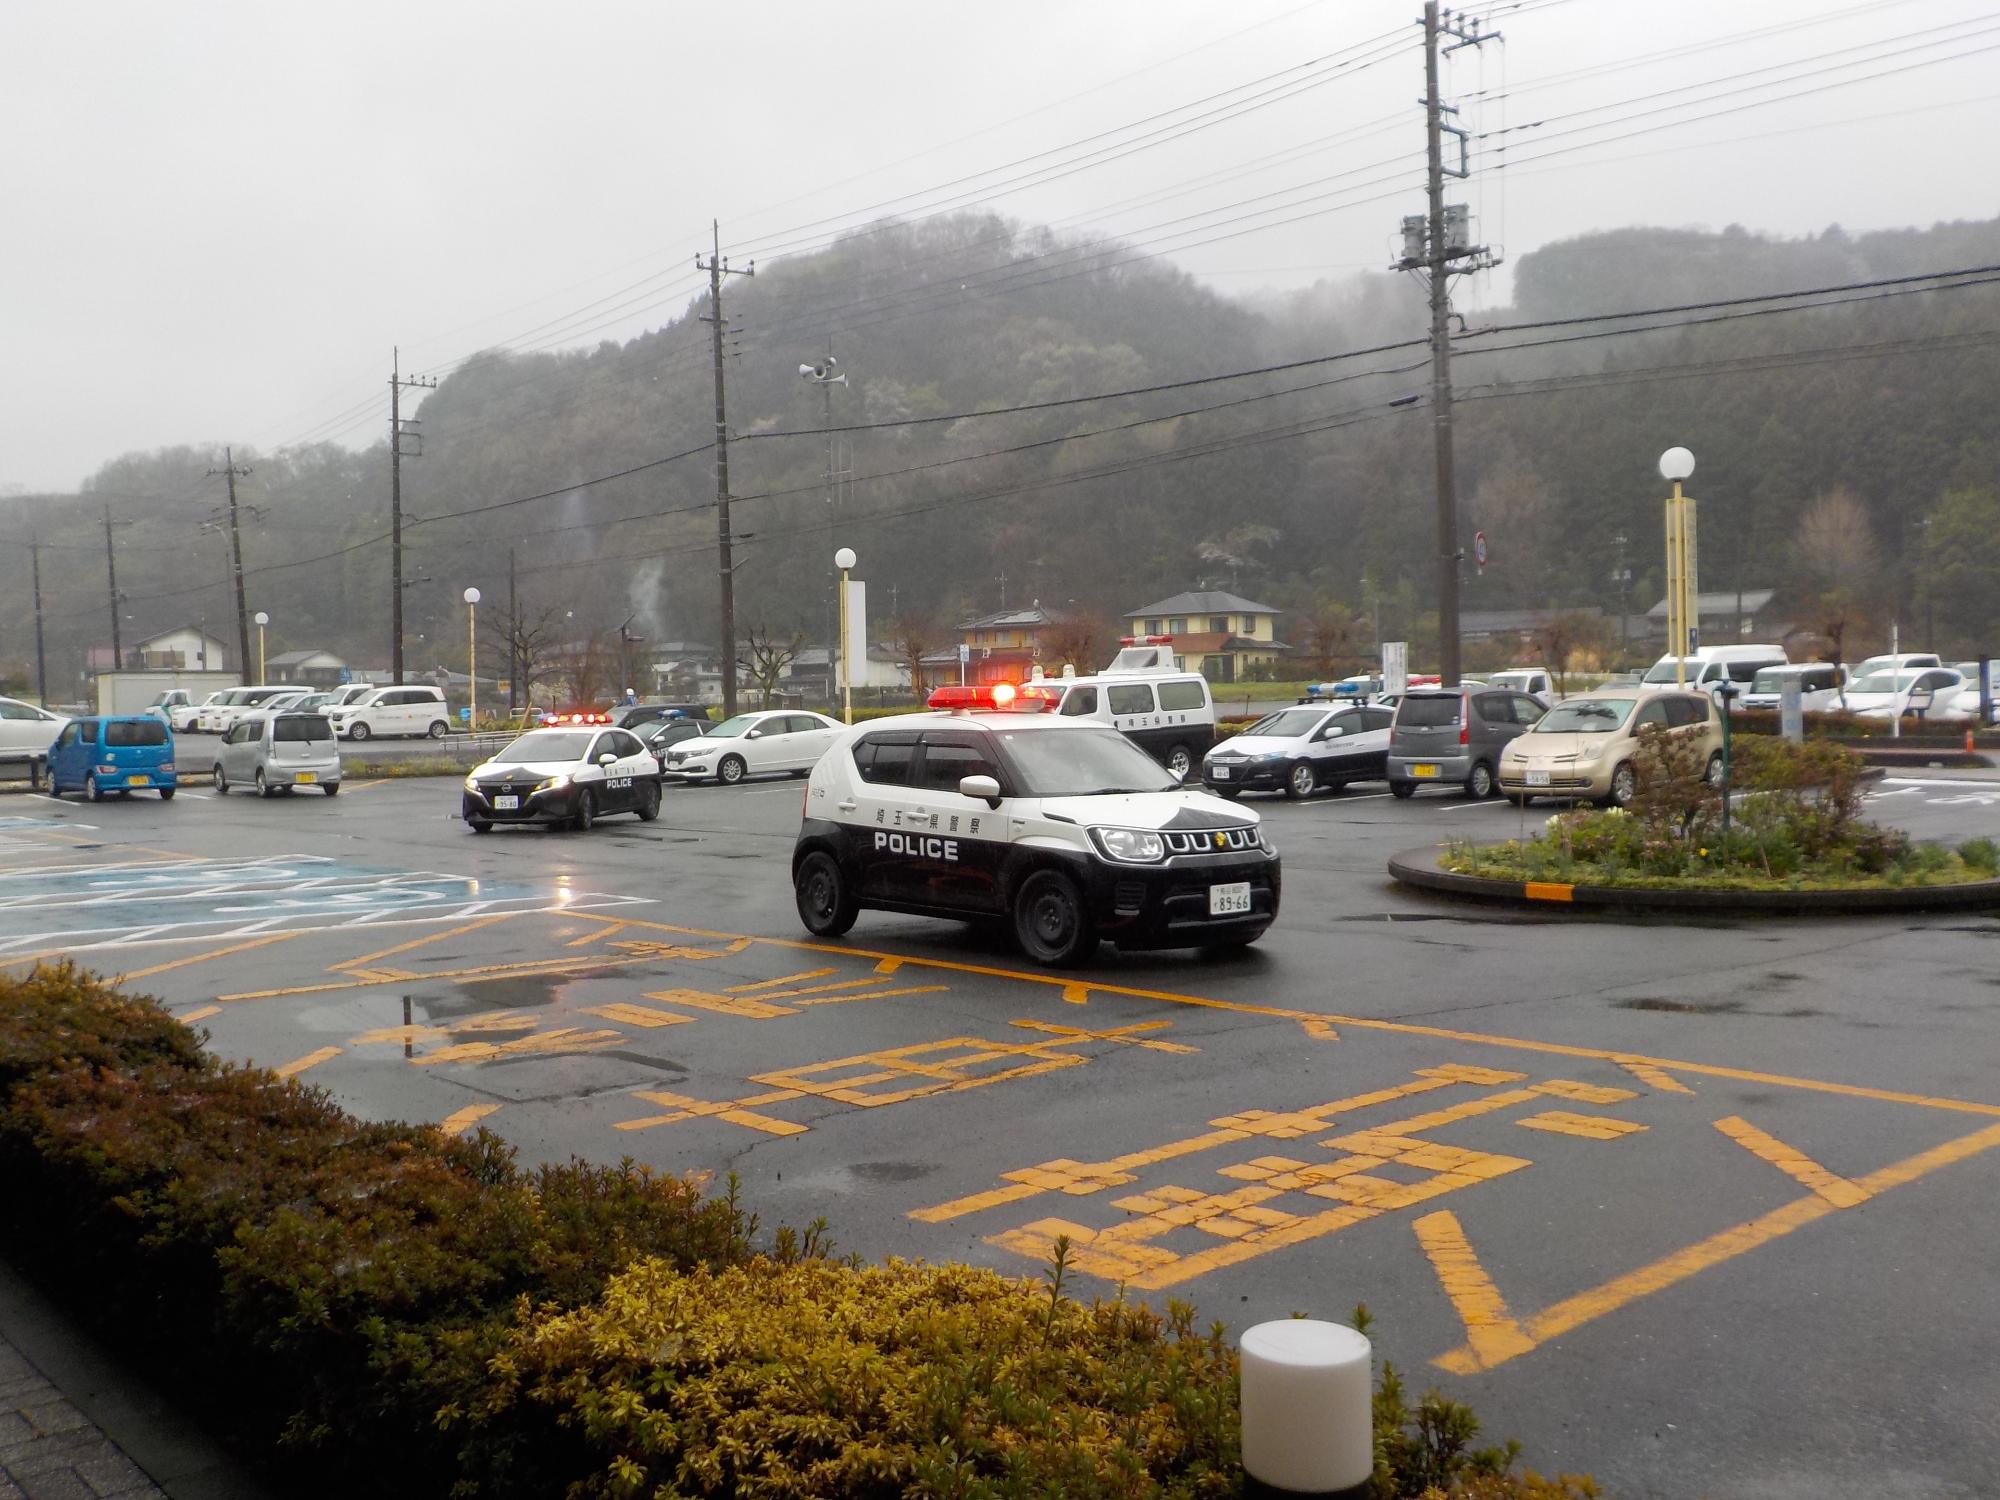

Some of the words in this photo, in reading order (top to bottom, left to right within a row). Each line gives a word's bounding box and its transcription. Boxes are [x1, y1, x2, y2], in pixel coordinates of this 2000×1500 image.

[606, 777, 632, 789] POLICE
[876, 807, 981, 835] 埼玉県警察
[874, 831, 959, 861] POLICE
[1219, 895, 1249, 911] 89-66
